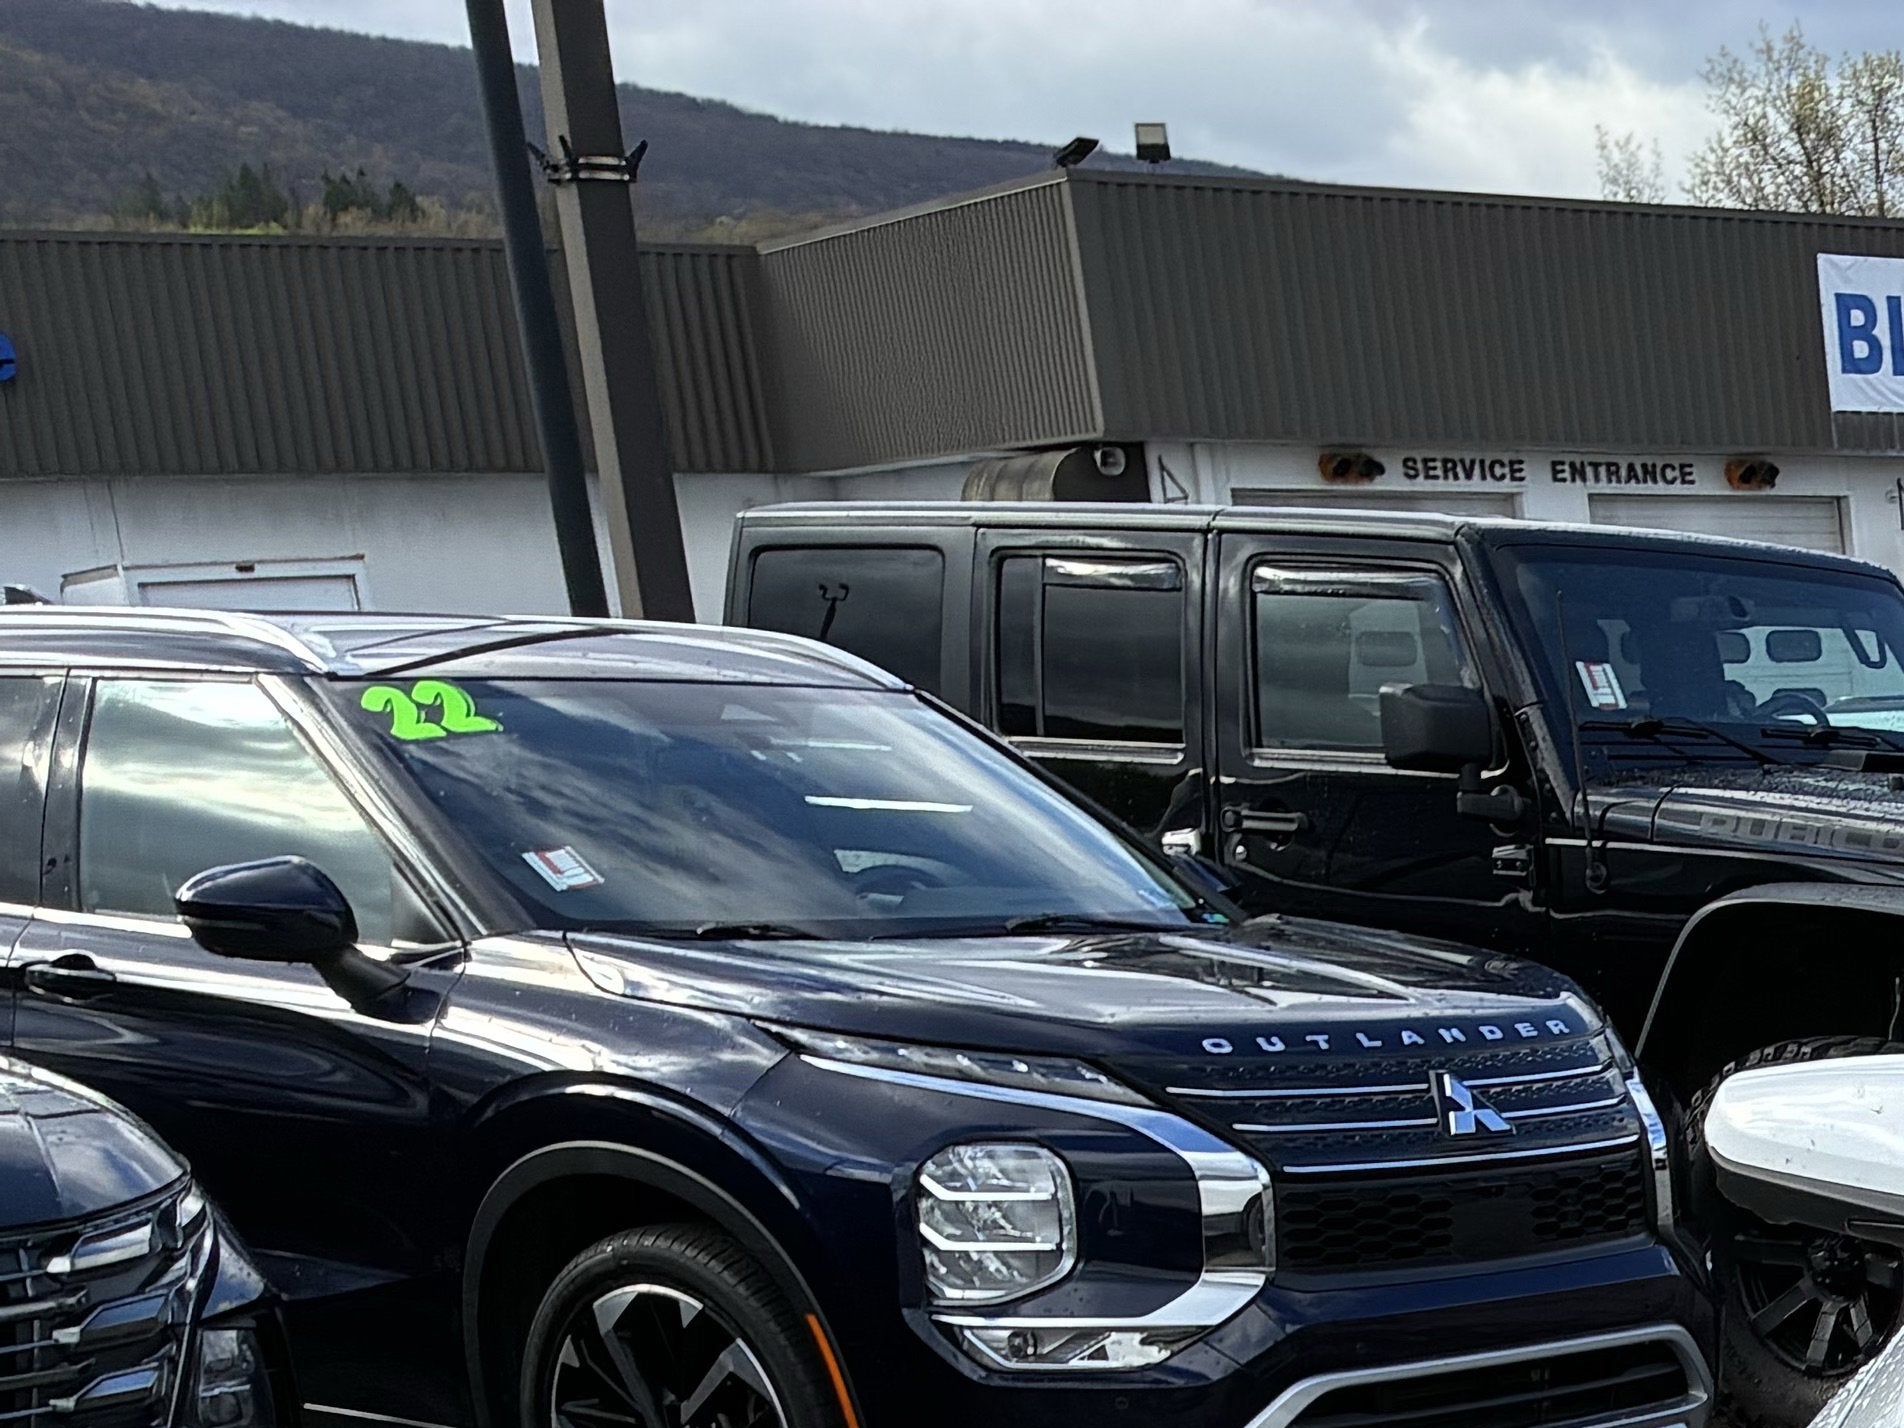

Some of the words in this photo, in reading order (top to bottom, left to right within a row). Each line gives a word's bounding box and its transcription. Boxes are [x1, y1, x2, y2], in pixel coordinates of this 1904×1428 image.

[1402, 456, 1527, 482] SERVICE
[1551, 459, 1697, 485] ENTRANCE
[361, 680, 504, 741] 22
[1202, 1019, 1570, 1054] OUTLANDER
